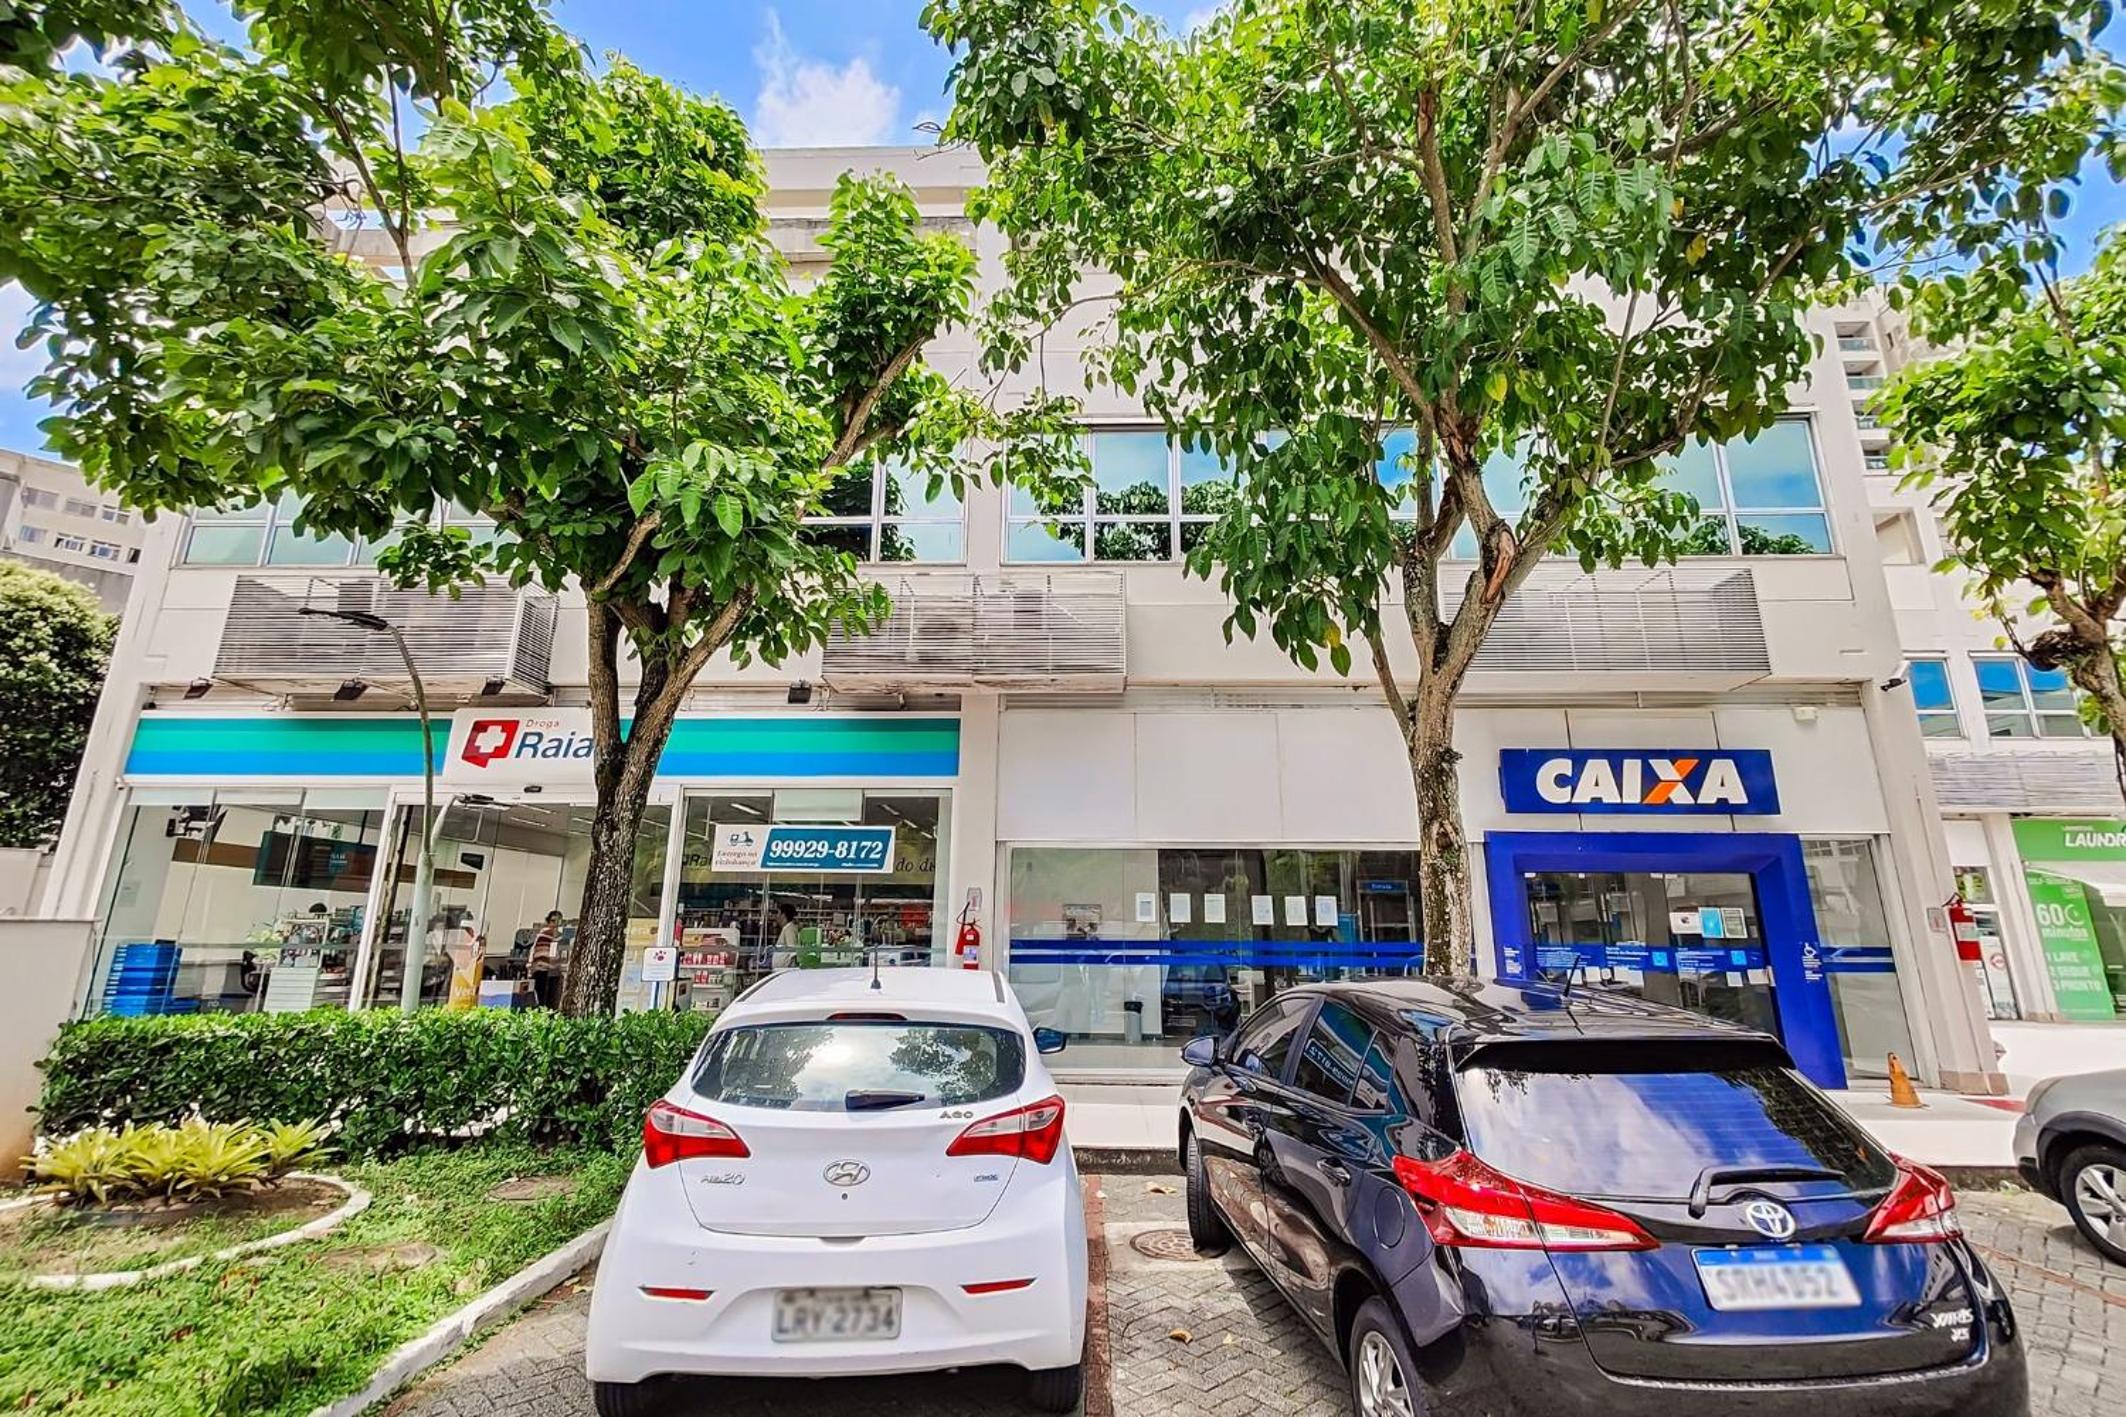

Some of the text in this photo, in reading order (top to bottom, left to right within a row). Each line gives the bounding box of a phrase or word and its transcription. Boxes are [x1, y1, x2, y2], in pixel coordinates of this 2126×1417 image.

[525, 719, 560, 729] Droga
[515, 731, 595, 759] Raia
[1535, 758, 1749, 805] CAIXA
[768, 839, 884, 860] 99929-8172
[2036, 903, 2065, 926] 60
